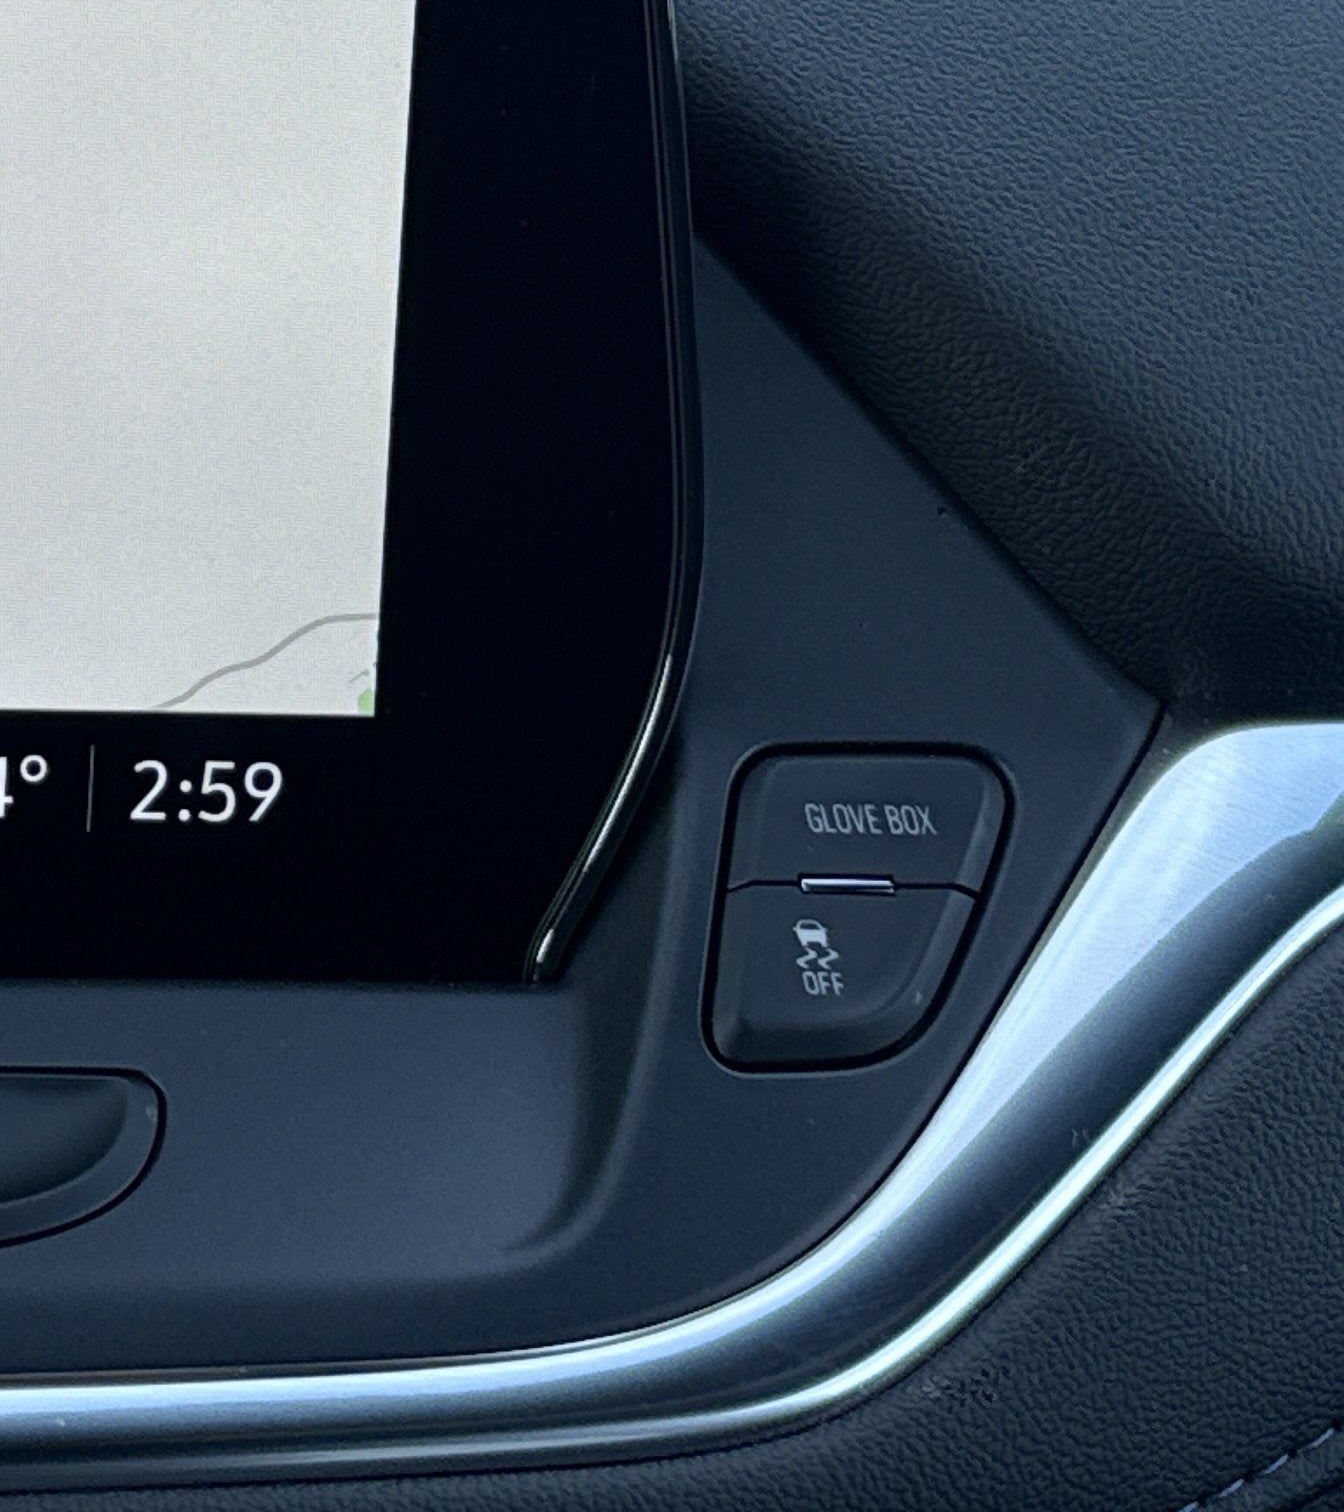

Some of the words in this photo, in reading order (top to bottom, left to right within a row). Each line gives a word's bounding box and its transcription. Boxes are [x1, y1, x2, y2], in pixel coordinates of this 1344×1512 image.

[129, 759, 284, 823] 2:59
[804, 802, 883, 835] GLOVE
[885, 804, 938, 836] BOX
[801, 971, 845, 995] OFF
